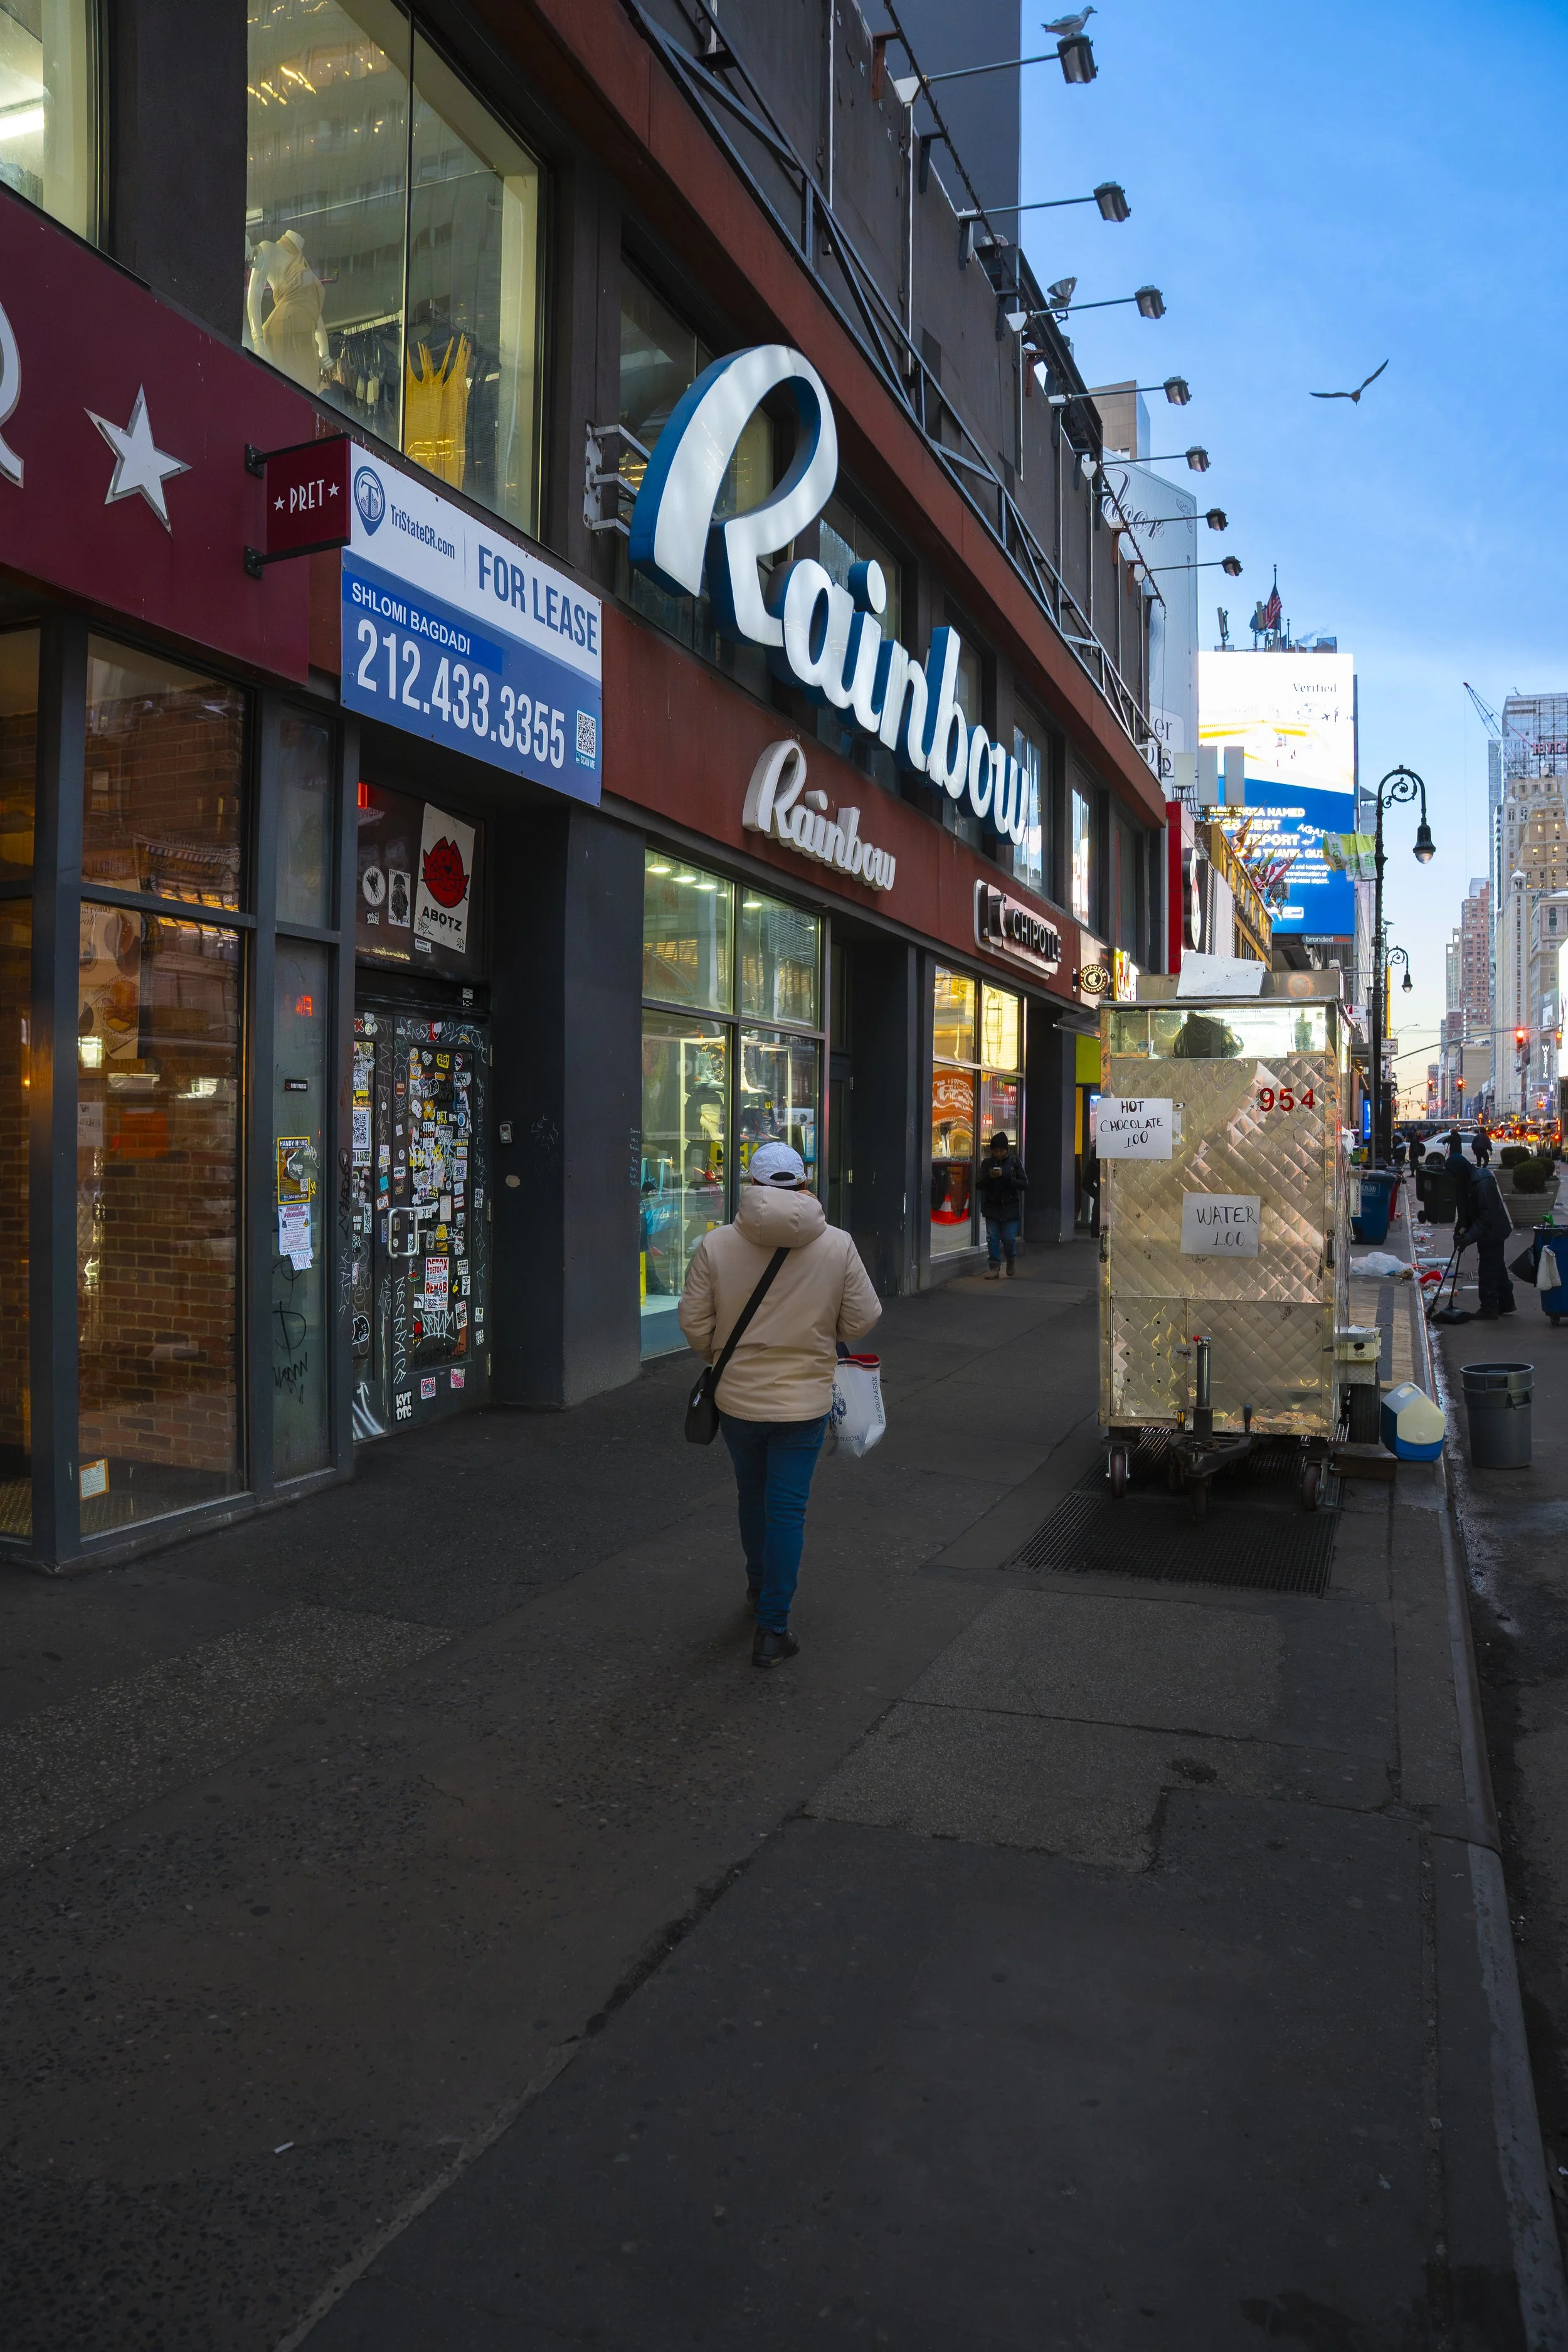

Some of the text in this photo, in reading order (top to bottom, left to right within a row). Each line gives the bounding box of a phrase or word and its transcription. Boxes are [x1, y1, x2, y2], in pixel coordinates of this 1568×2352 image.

[290, 479, 324, 513] PRET
[390, 504, 455, 559] TriStateCR.com
[479, 544, 598, 656] FOR LEASE
[630, 344, 1030, 846] Rainbow
[352, 582, 470, 655] SHLOMI BAGDADI
[358, 619, 565, 769] 212.433.3355
[1293, 682, 1337, 692] Verified
[581, 755, 595, 770] SCAN ME
[743, 739, 896, 892] Rainbow
[1267, 807, 1306, 817] NAMED
[421, 906, 462, 932] ABOTZ
[1012, 908, 1062, 963] CHIPOTLE
[1079, 965, 1107, 977] CHIPOTLE
[1541, 1045, 1550, 1079] WESTIN
[1120, 1100, 1144, 1113] HOT
[1259, 1087, 1316, 1112] 954
[1100, 1117, 1164, 1133] CHOCOLATE
[1123, 1131, 1148, 1148] 1.00
[1196, 1205, 1258, 1226] WATER
[1212, 1231, 1245, 1247] 1.00
[429, 1266, 442, 1274] DETOX
